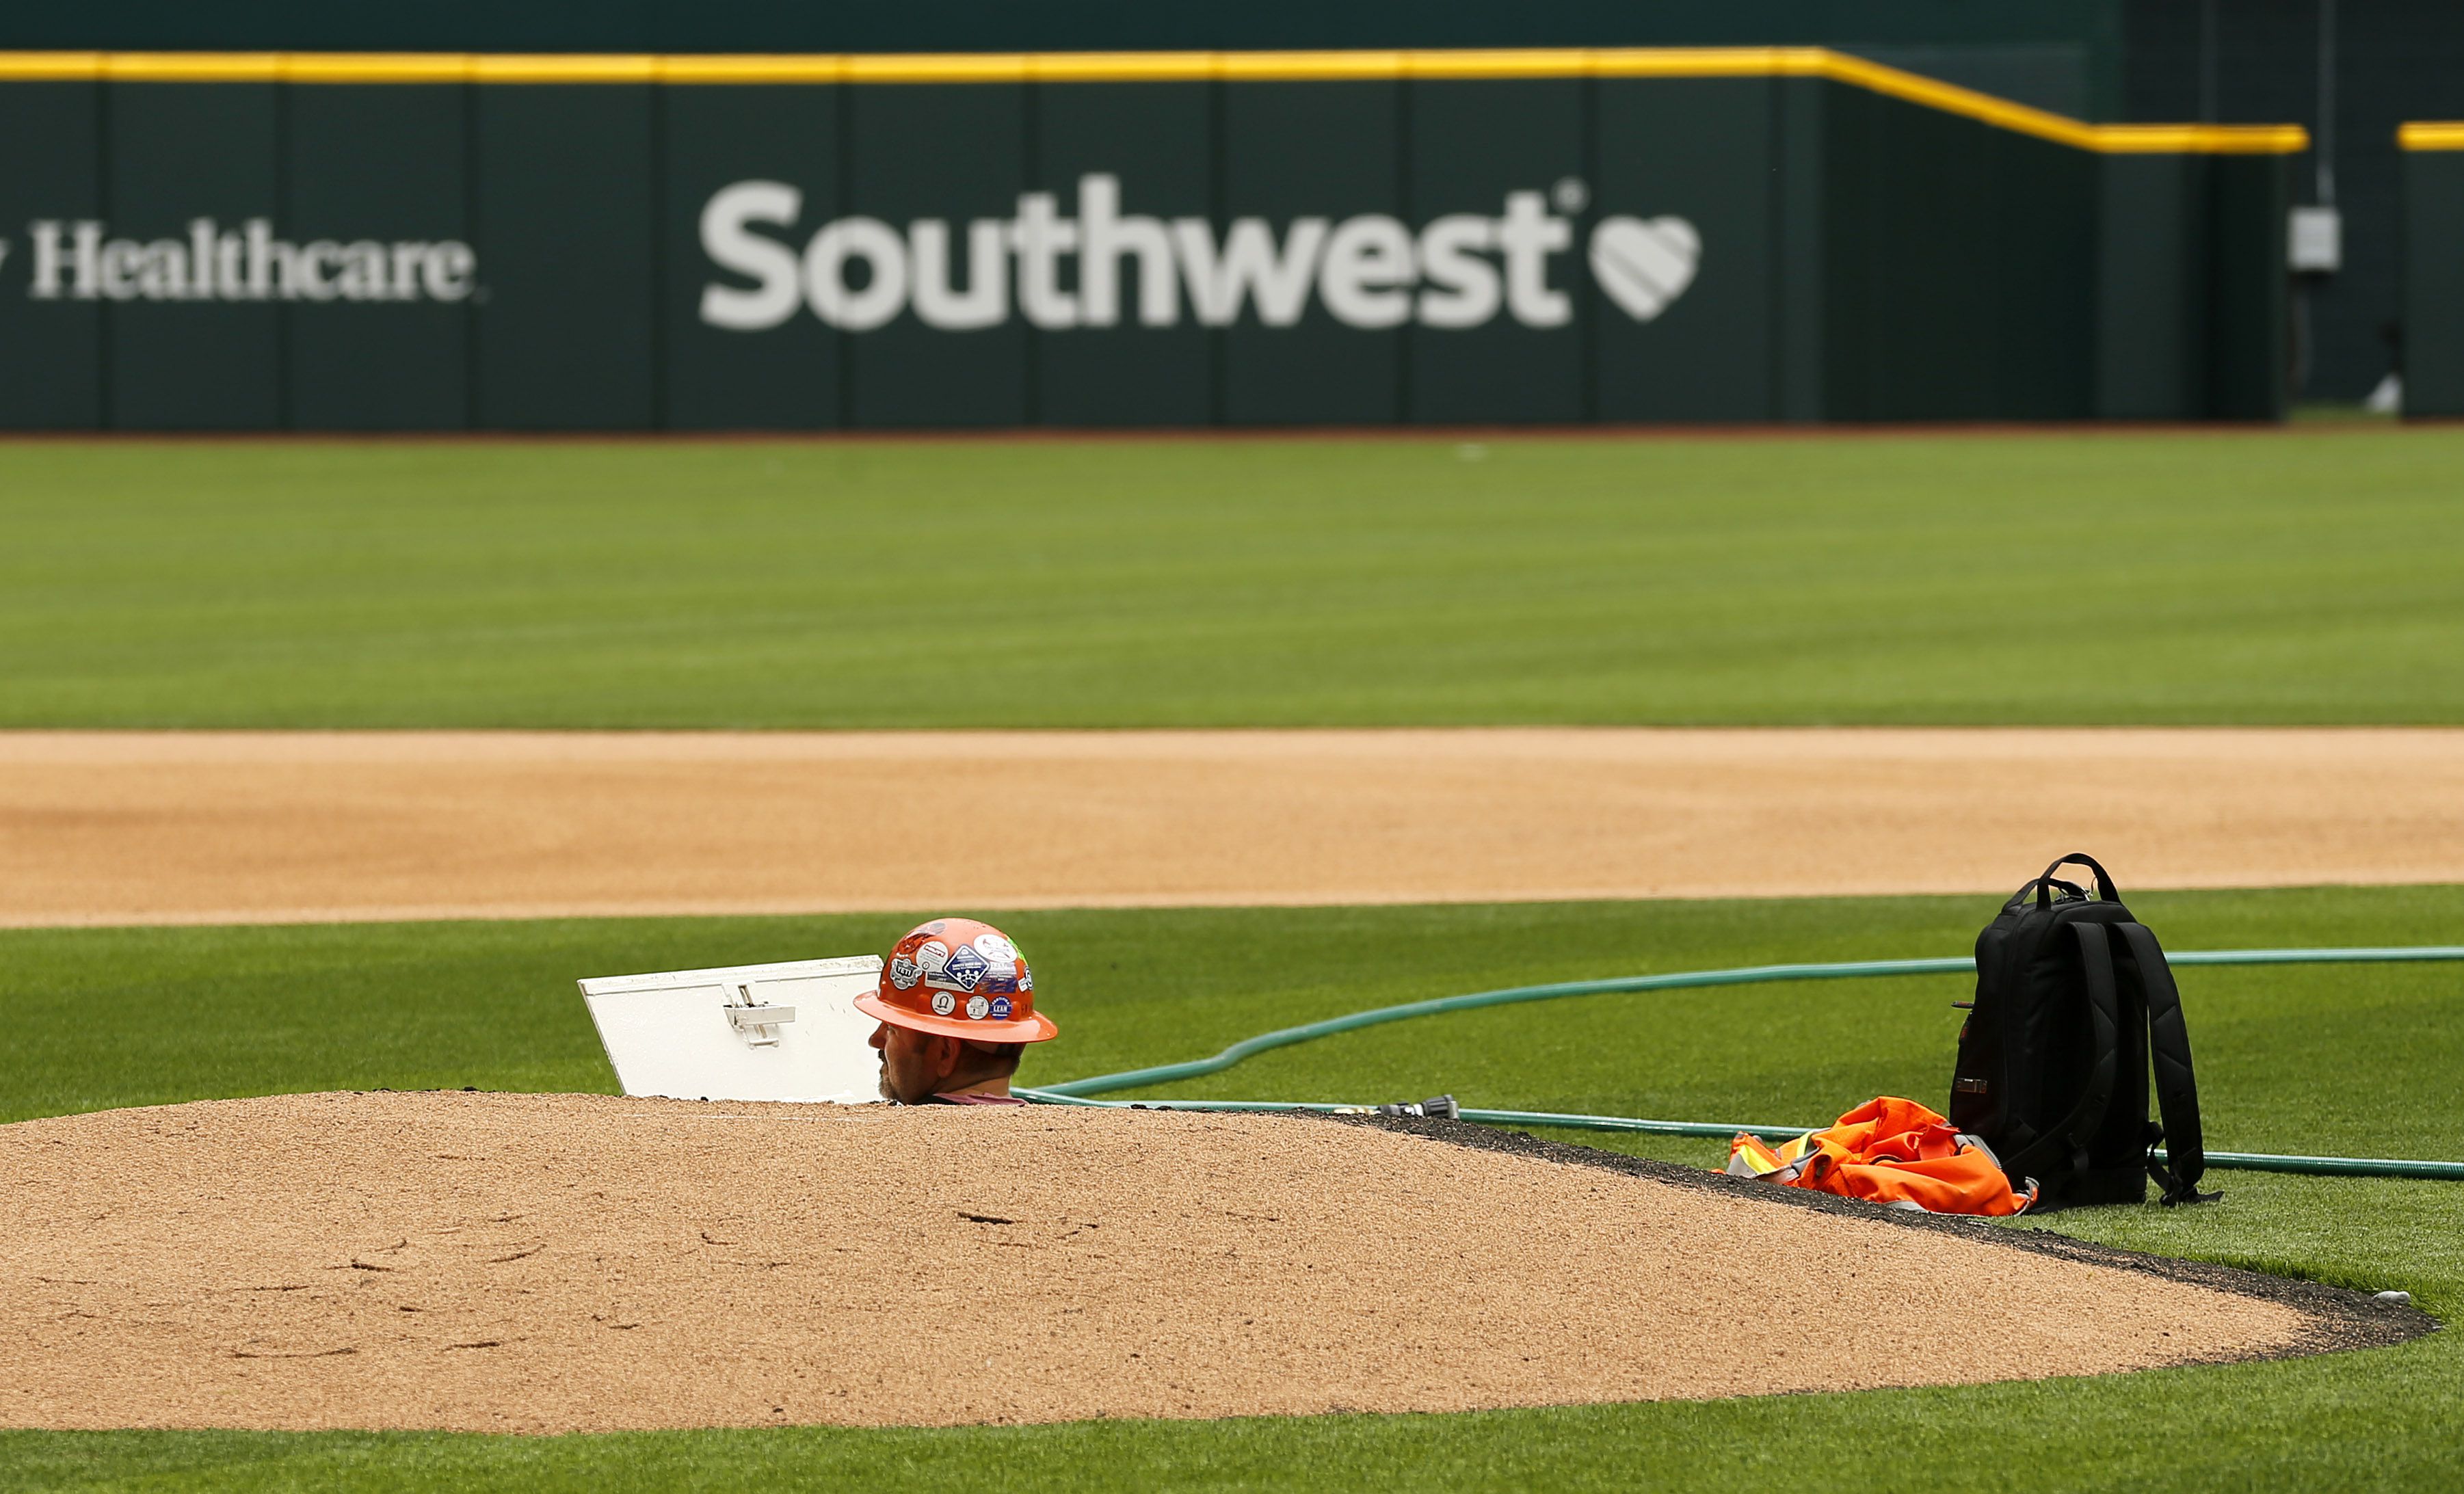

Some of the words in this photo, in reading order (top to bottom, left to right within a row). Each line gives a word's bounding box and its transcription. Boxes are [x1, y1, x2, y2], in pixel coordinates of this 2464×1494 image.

[27, 217, 475, 302] Healthcare
[698, 174, 1572, 330] Southwest
[897, 965, 912, 976] YETI
